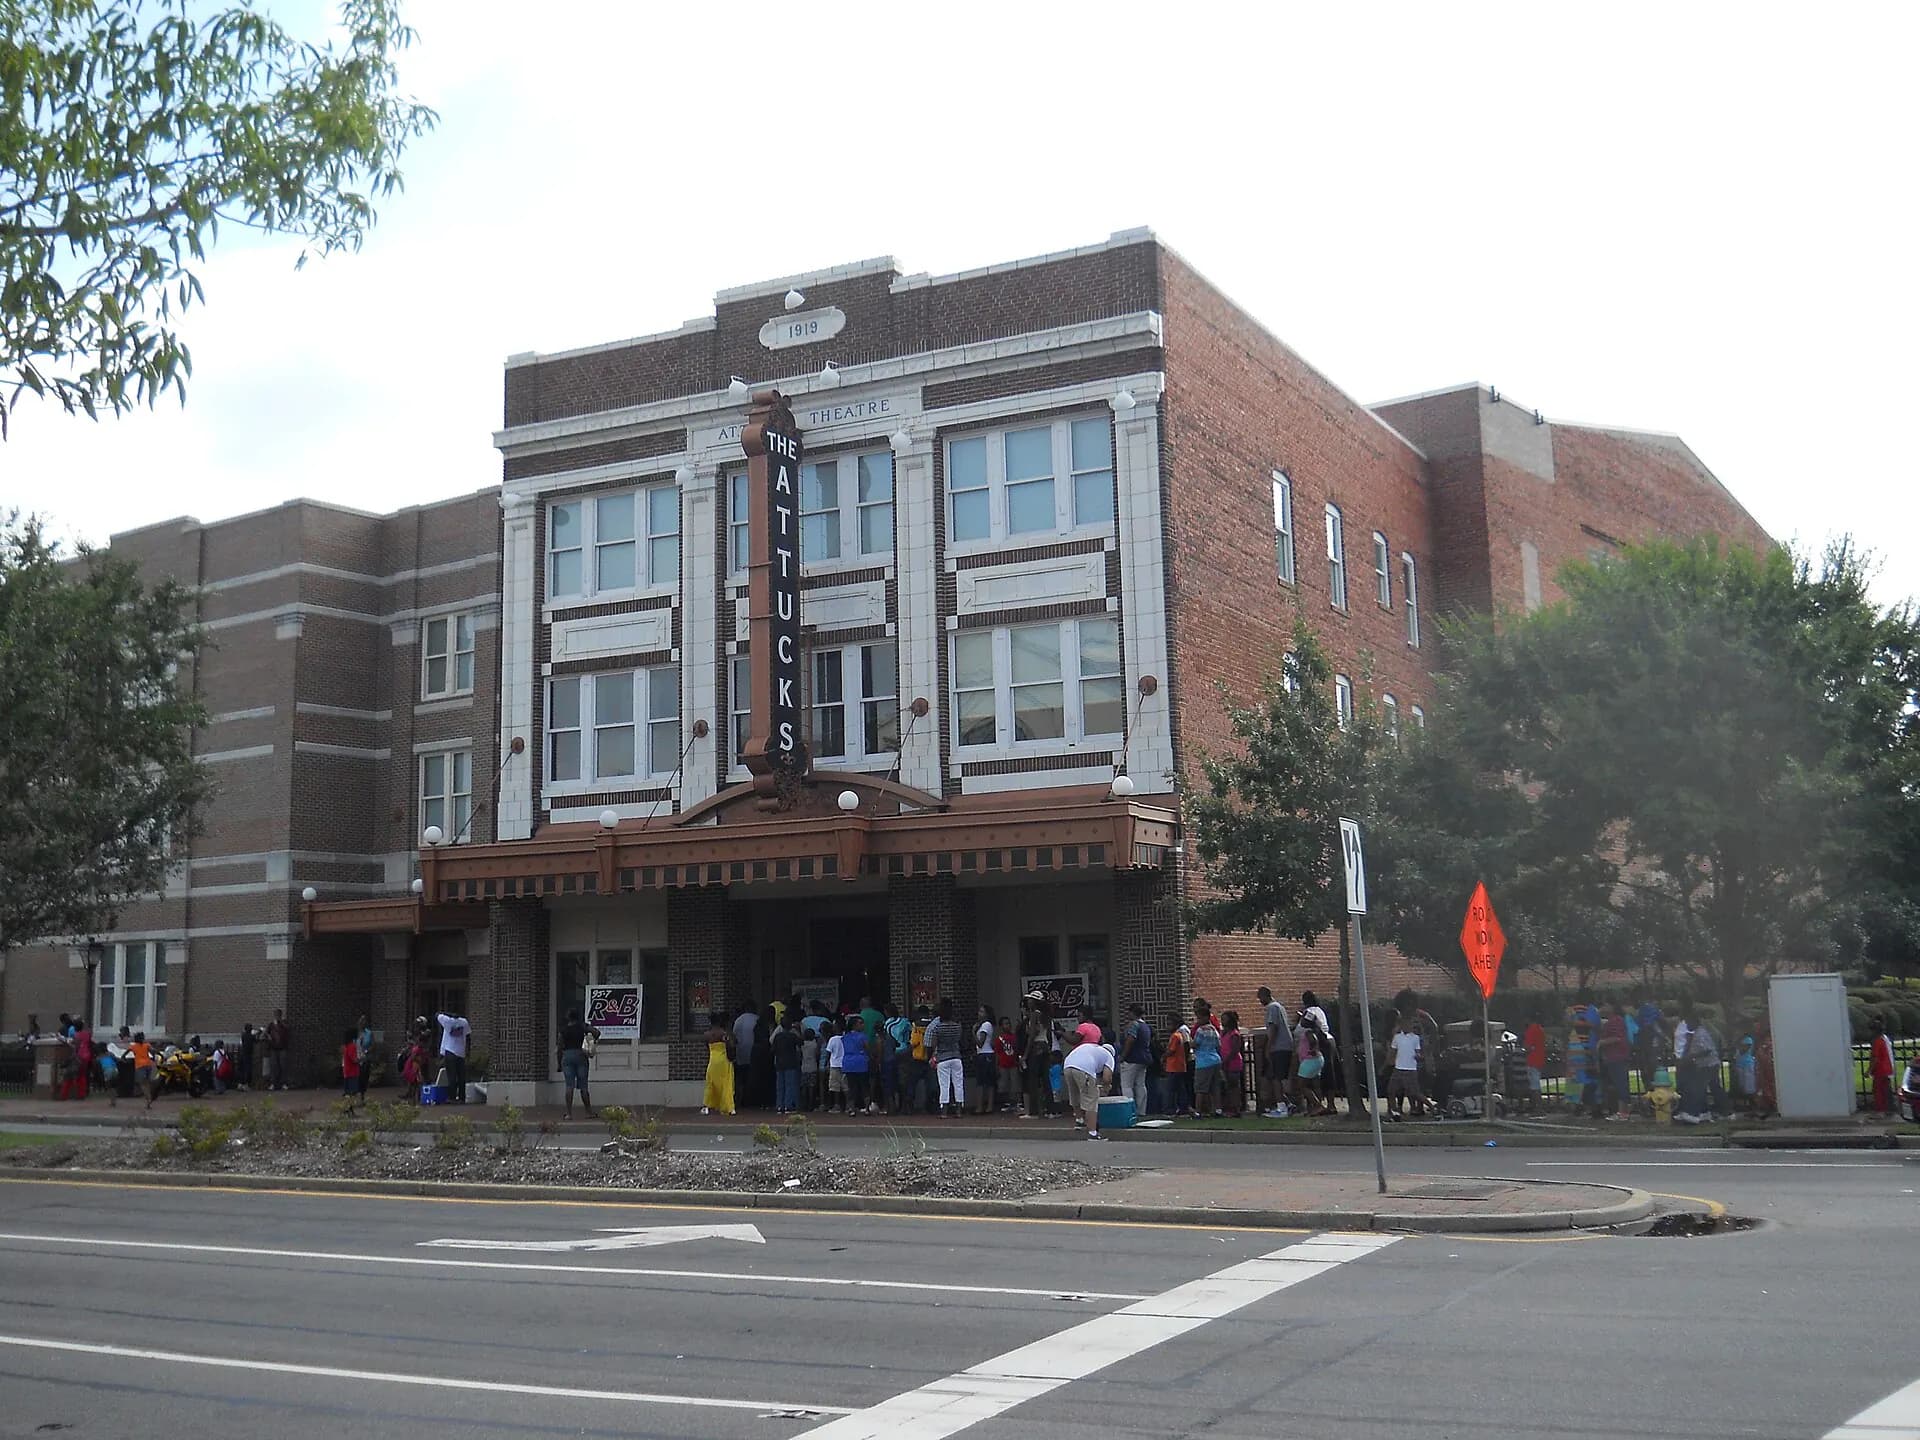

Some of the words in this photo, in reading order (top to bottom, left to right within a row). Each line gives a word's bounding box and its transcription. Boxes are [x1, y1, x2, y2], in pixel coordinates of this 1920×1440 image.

[788, 320, 819, 339] 1919
[810, 399, 890, 424] THEATRE
[766, 430, 797, 461] THE
[775, 464, 794, 752] ATTUCKS
[591, 989, 612, 999] 95.7
[587, 994, 640, 1021] R&B
